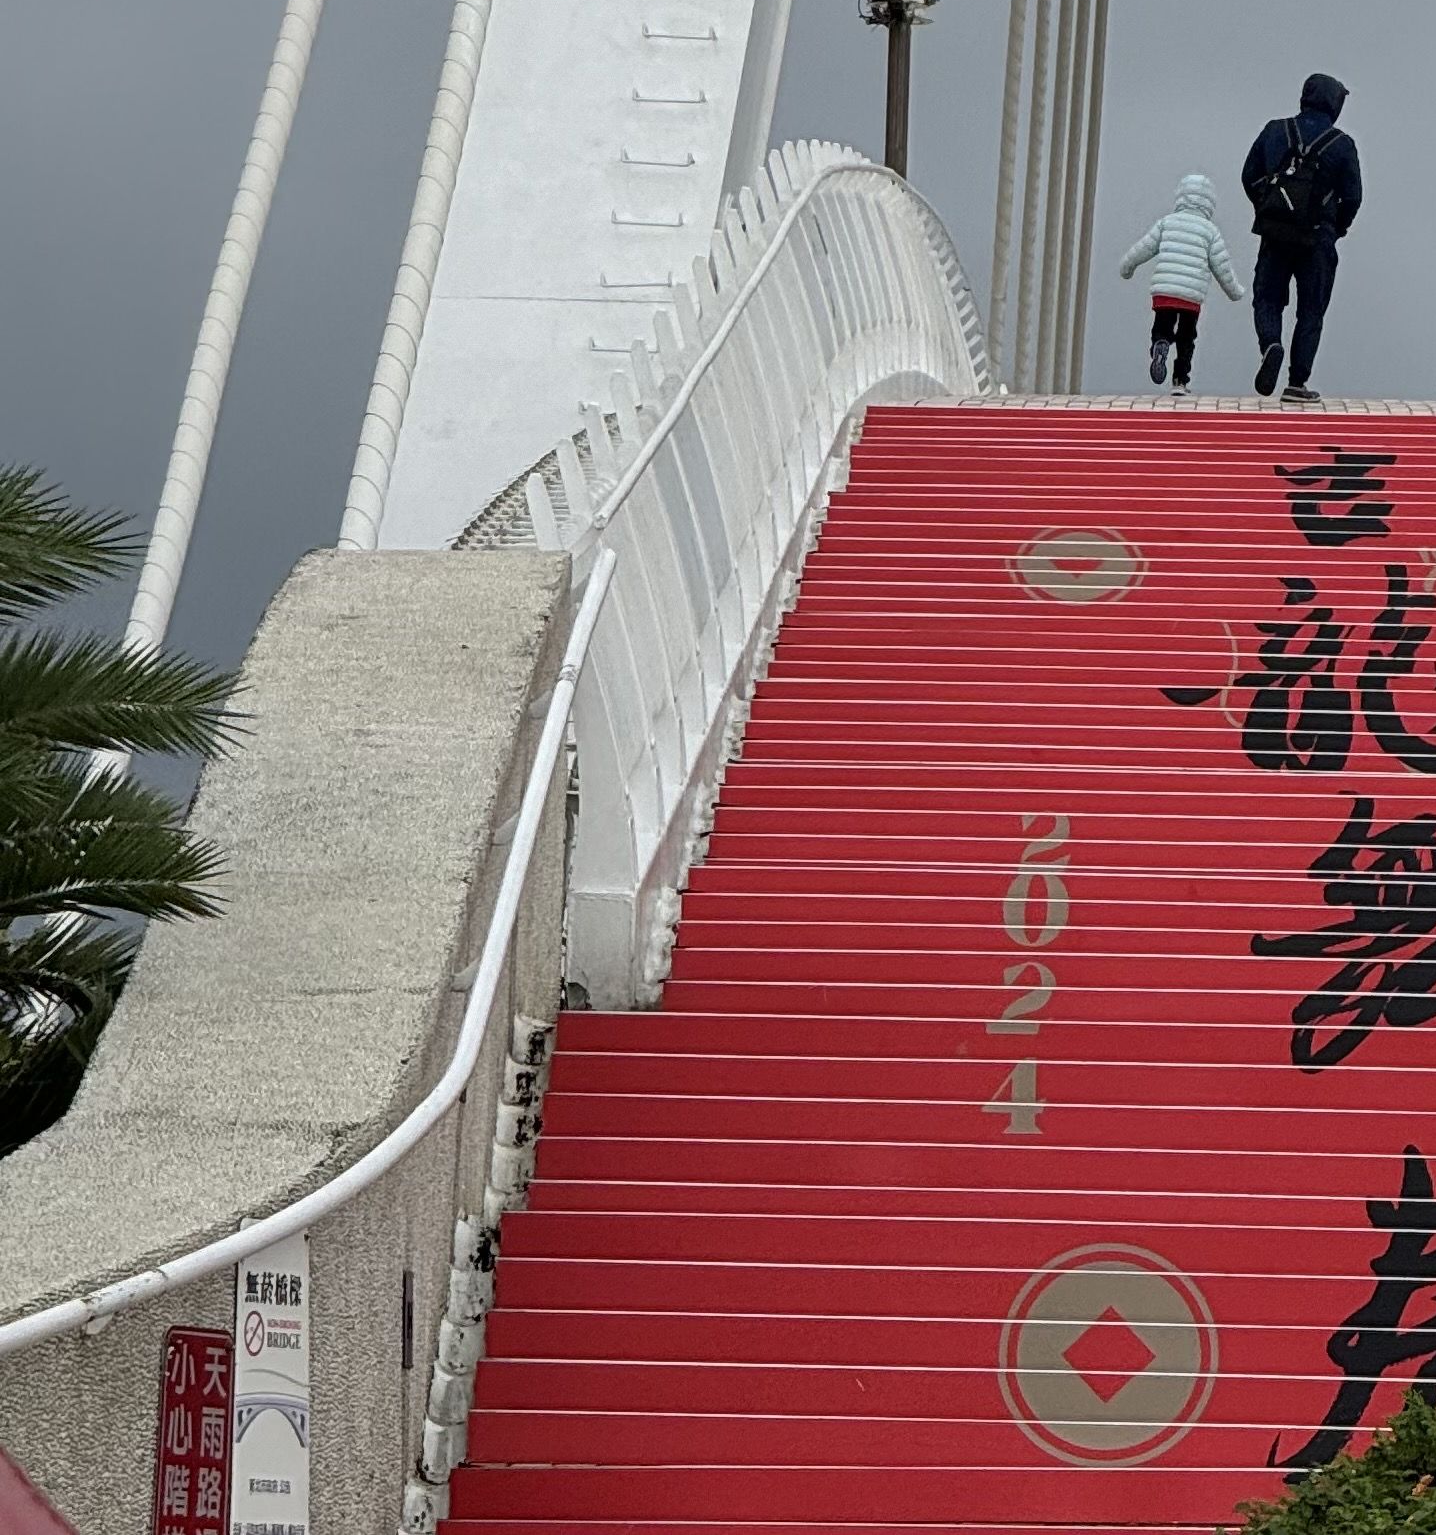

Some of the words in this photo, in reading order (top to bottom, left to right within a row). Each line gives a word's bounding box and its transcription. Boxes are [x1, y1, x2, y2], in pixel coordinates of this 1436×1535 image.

[981, 811, 1071, 1135] 2024
[267, 1332, 302, 1349] BRIDGE
[162, 1343, 196, 1535] 小心階
[195, 1346, 228, 1535] 天雨路
